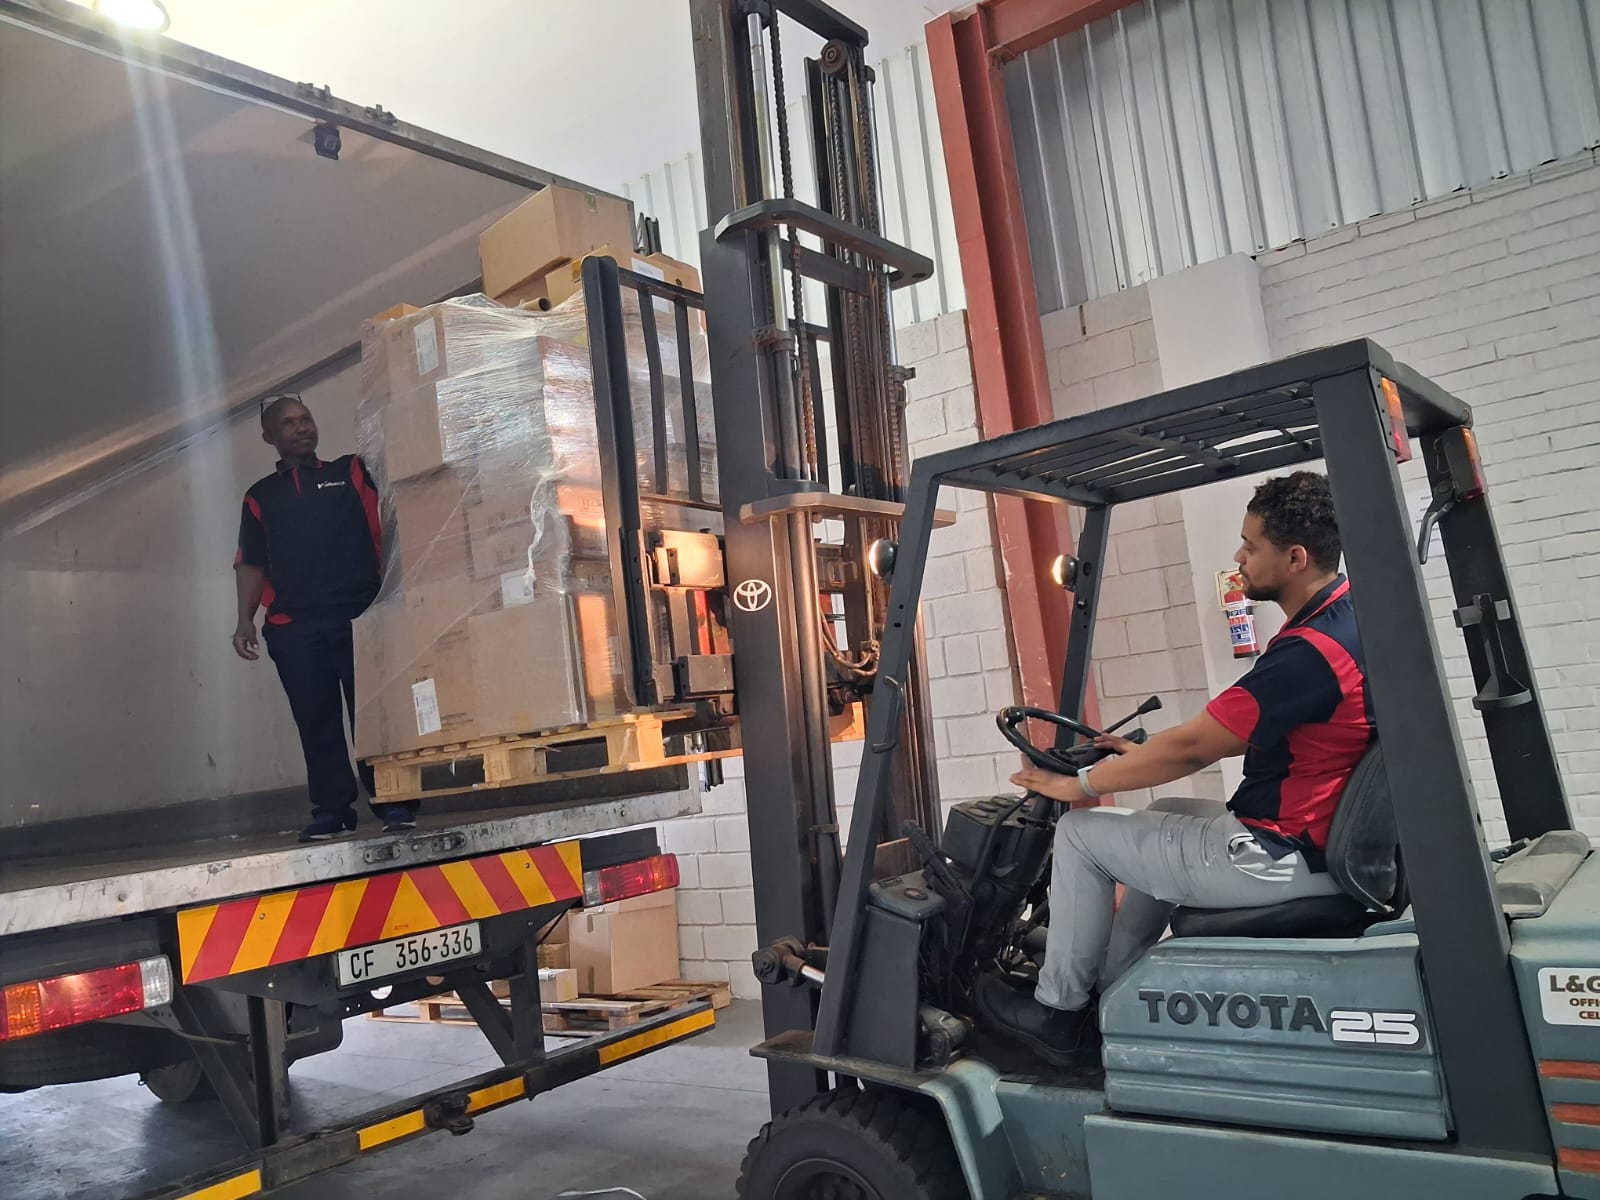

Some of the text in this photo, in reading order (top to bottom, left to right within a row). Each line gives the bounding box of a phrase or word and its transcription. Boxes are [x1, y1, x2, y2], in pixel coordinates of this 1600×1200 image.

[350, 928, 473, 979] CF 356-336
[1138, 988, 1420, 1045] TOYOTA 25
